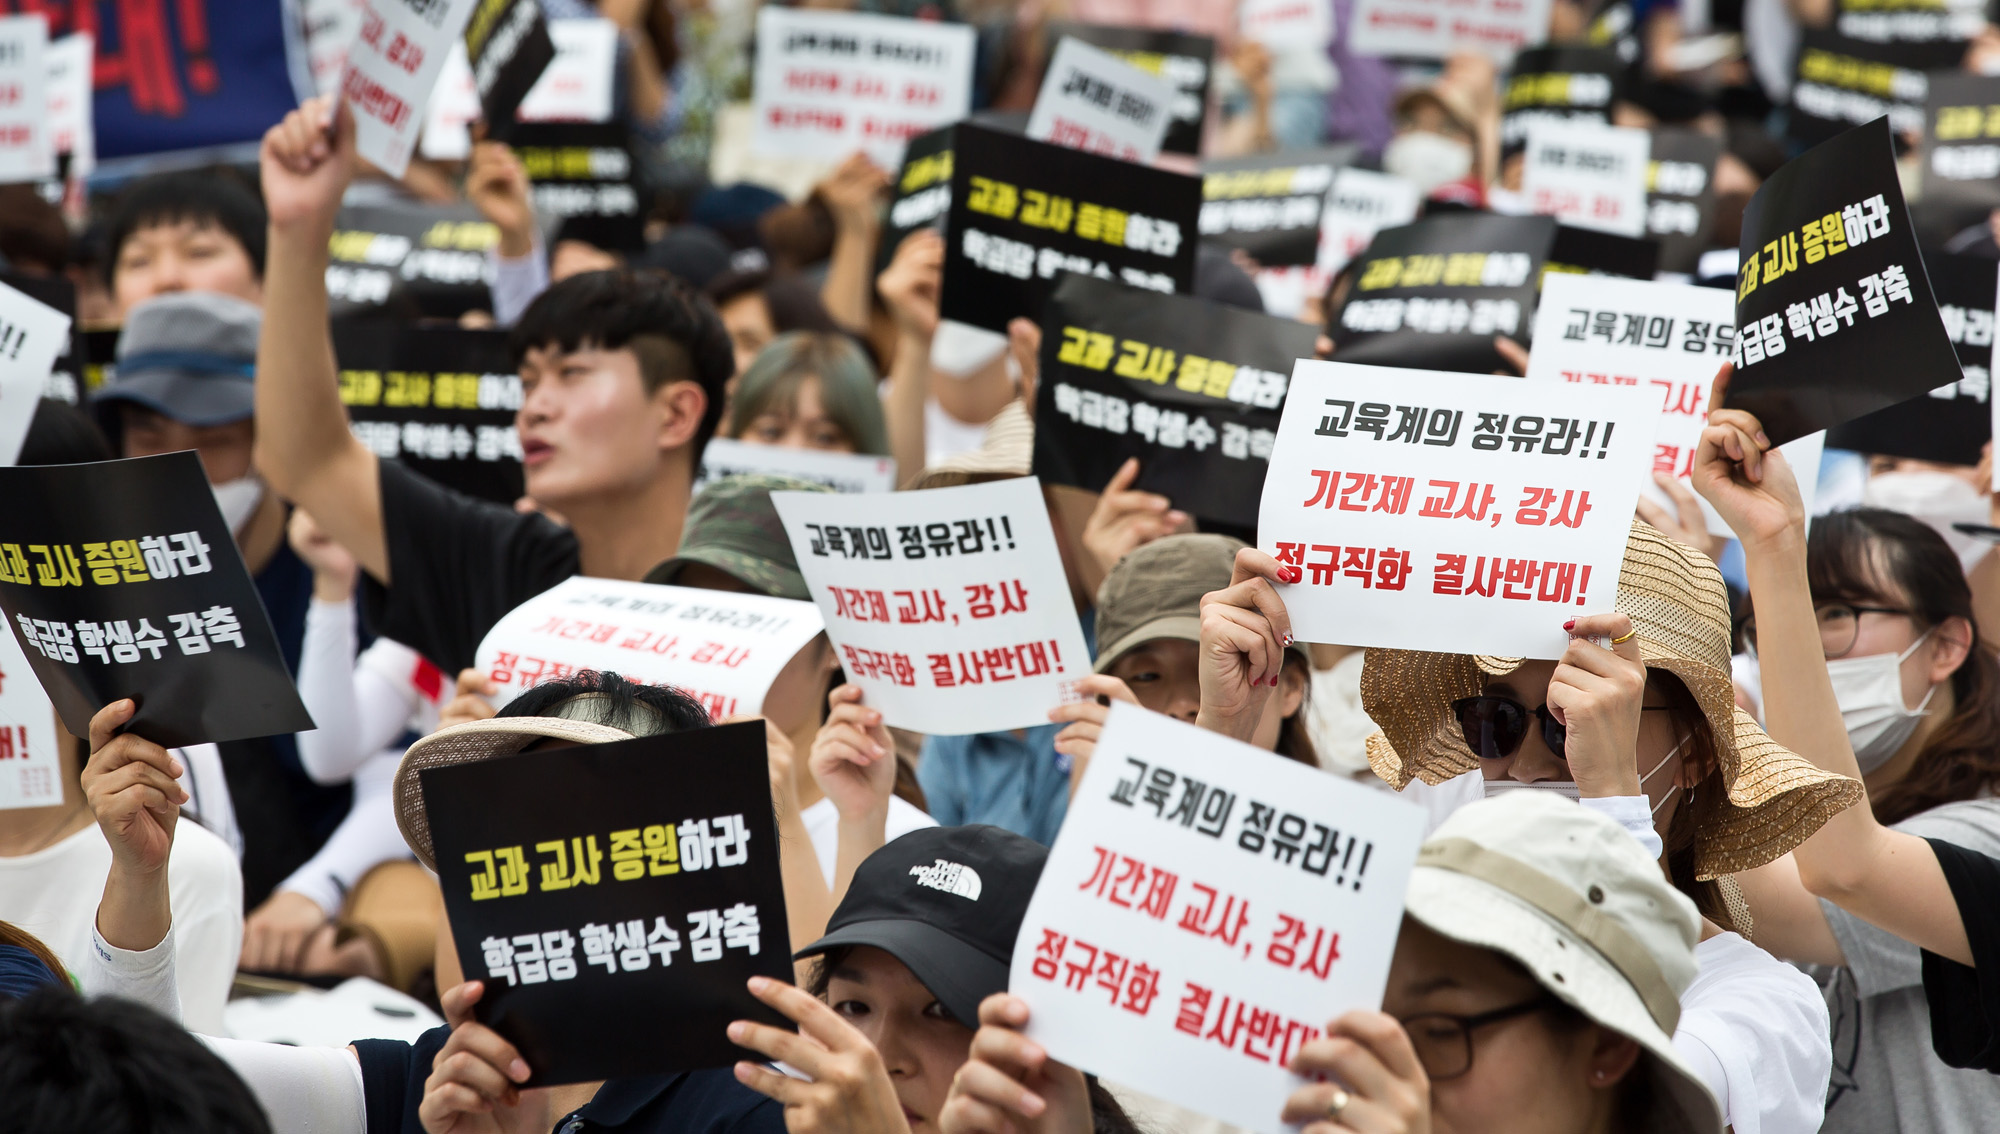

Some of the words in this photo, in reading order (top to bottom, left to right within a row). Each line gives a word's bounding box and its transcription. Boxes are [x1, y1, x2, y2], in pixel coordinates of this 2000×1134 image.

[967, 175, 1018, 220] 교과
[1019, 188, 1074, 232] 교사
[1074, 202, 1181, 257] 증원하라
[1763, 231, 1799, 285] 교사
[1802, 194, 1890, 264] 증원하라
[1563, 308, 1674, 349] 교육계의
[1785, 286, 1859, 342] 학생수
[1858, 265, 1913, 318] 감축
[1057, 326, 1115, 371] 교과
[1113, 339, 1175, 385] 교사
[1175, 354, 1287, 409] 증원하라
[1054, 382, 1130, 434] 학급당
[1132, 401, 1216, 451] 학생수
[1314, 397, 1464, 448] 교육계의
[1471, 411, 1616, 460] 정유라!!
[1302, 468, 1415, 515] 기간제
[1418, 479, 1502, 529] 교사,
[1515, 485, 1593, 530] 강사
[28, 544, 83, 587] 교사
[82, 531, 213, 586] 증원하라
[804, 521, 893, 561] 교육계의
[897, 515, 1017, 560] 정유라!!
[826, 584, 890, 624] 기간제
[893, 588, 961, 626] 교사,
[964, 578, 1029, 620] 강사
[1275, 541, 1412, 592] 정규직화
[1432, 552, 1593, 606] 결사반대!
[15, 612, 80, 664] 학급당
[75, 617, 168, 665] 학생수
[167, 605, 246, 656] 감축
[532, 615, 620, 644] 기간제
[618, 628, 679, 660] 교사,
[690, 641, 751, 669] 강사
[841, 642, 917, 688] 정규직화
[926, 638, 1065, 689] 결사반대!
[1108, 755, 1238, 840] 교육계의
[1238, 799, 1374, 892] 정유라!!
[464, 845, 530, 901] 교과
[535, 834, 603, 892] 교사
[610, 812, 751, 882] 증원하라
[909, 865, 960, 884] NORTH
[917, 877, 954, 893] FACE
[934, 858, 962, 874] THE
[480, 928, 578, 988] 학급당
[579, 915, 682, 975] 학생수
[686, 901, 761, 963] 감축
[1078, 845, 1180, 922] 기간제
[1177, 882, 1255, 960] 교사,
[1265, 913, 1342, 982] 강사
[1031, 927, 1162, 1018] 정규직화
